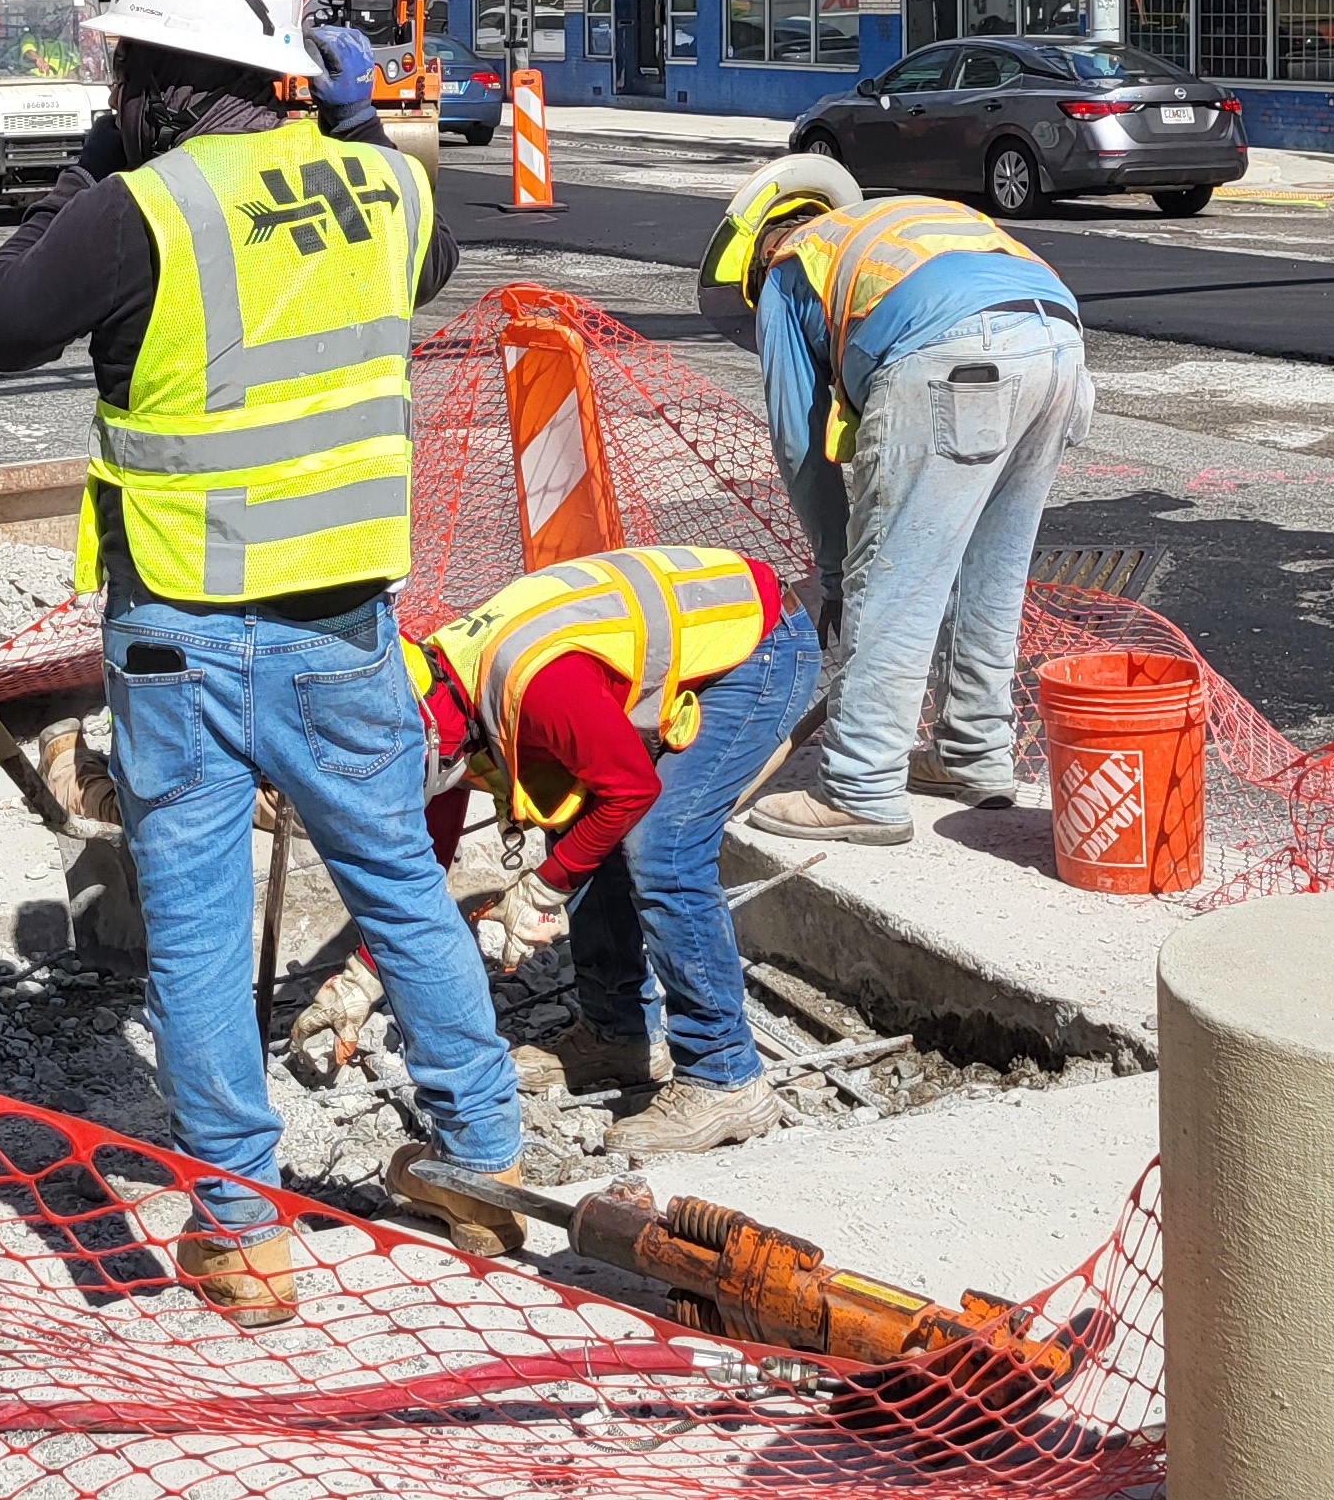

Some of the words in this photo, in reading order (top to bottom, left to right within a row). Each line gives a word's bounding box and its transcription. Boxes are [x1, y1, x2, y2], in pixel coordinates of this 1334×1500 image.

[1056, 759, 1088, 800] THE
[1056, 753, 1141, 856] HOME
[1082, 793, 1142, 862] DEPOT
